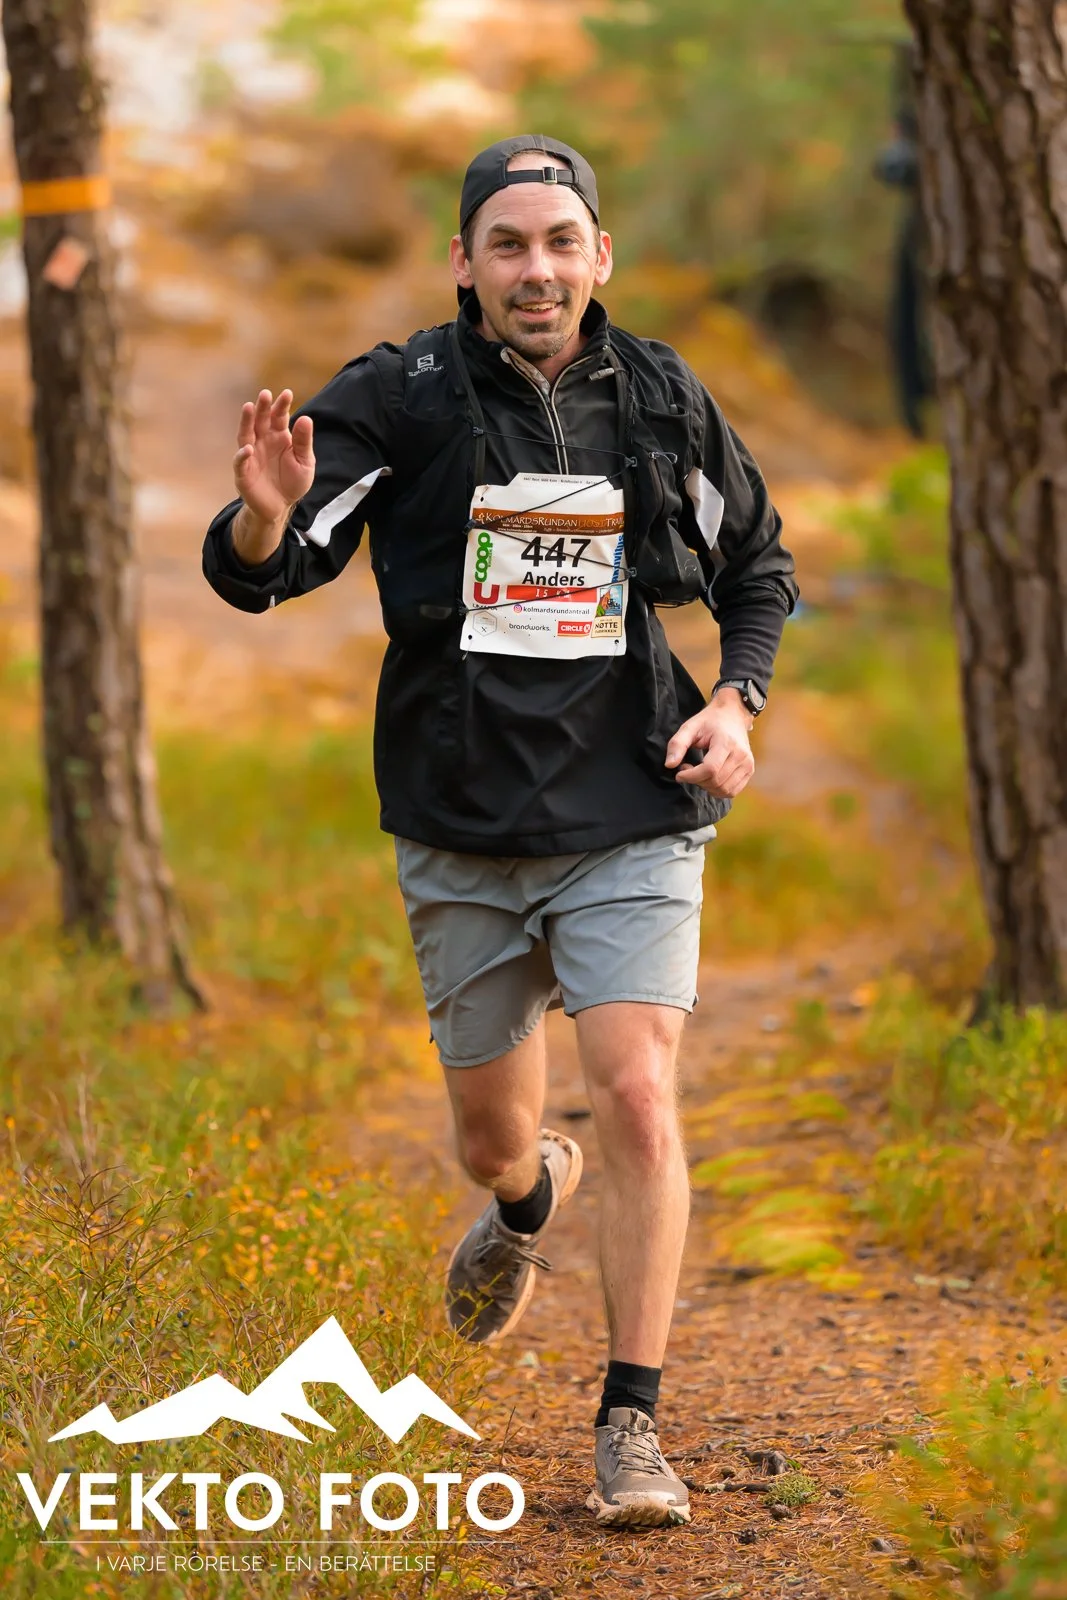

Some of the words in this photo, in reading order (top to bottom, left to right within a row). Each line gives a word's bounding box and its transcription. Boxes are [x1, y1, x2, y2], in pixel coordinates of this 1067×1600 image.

[475, 532, 493, 582] coop
[521, 536, 591, 567] 447
[522, 571, 585, 587] Anders
[523, 607, 590, 615] kolmardsrundantrail
